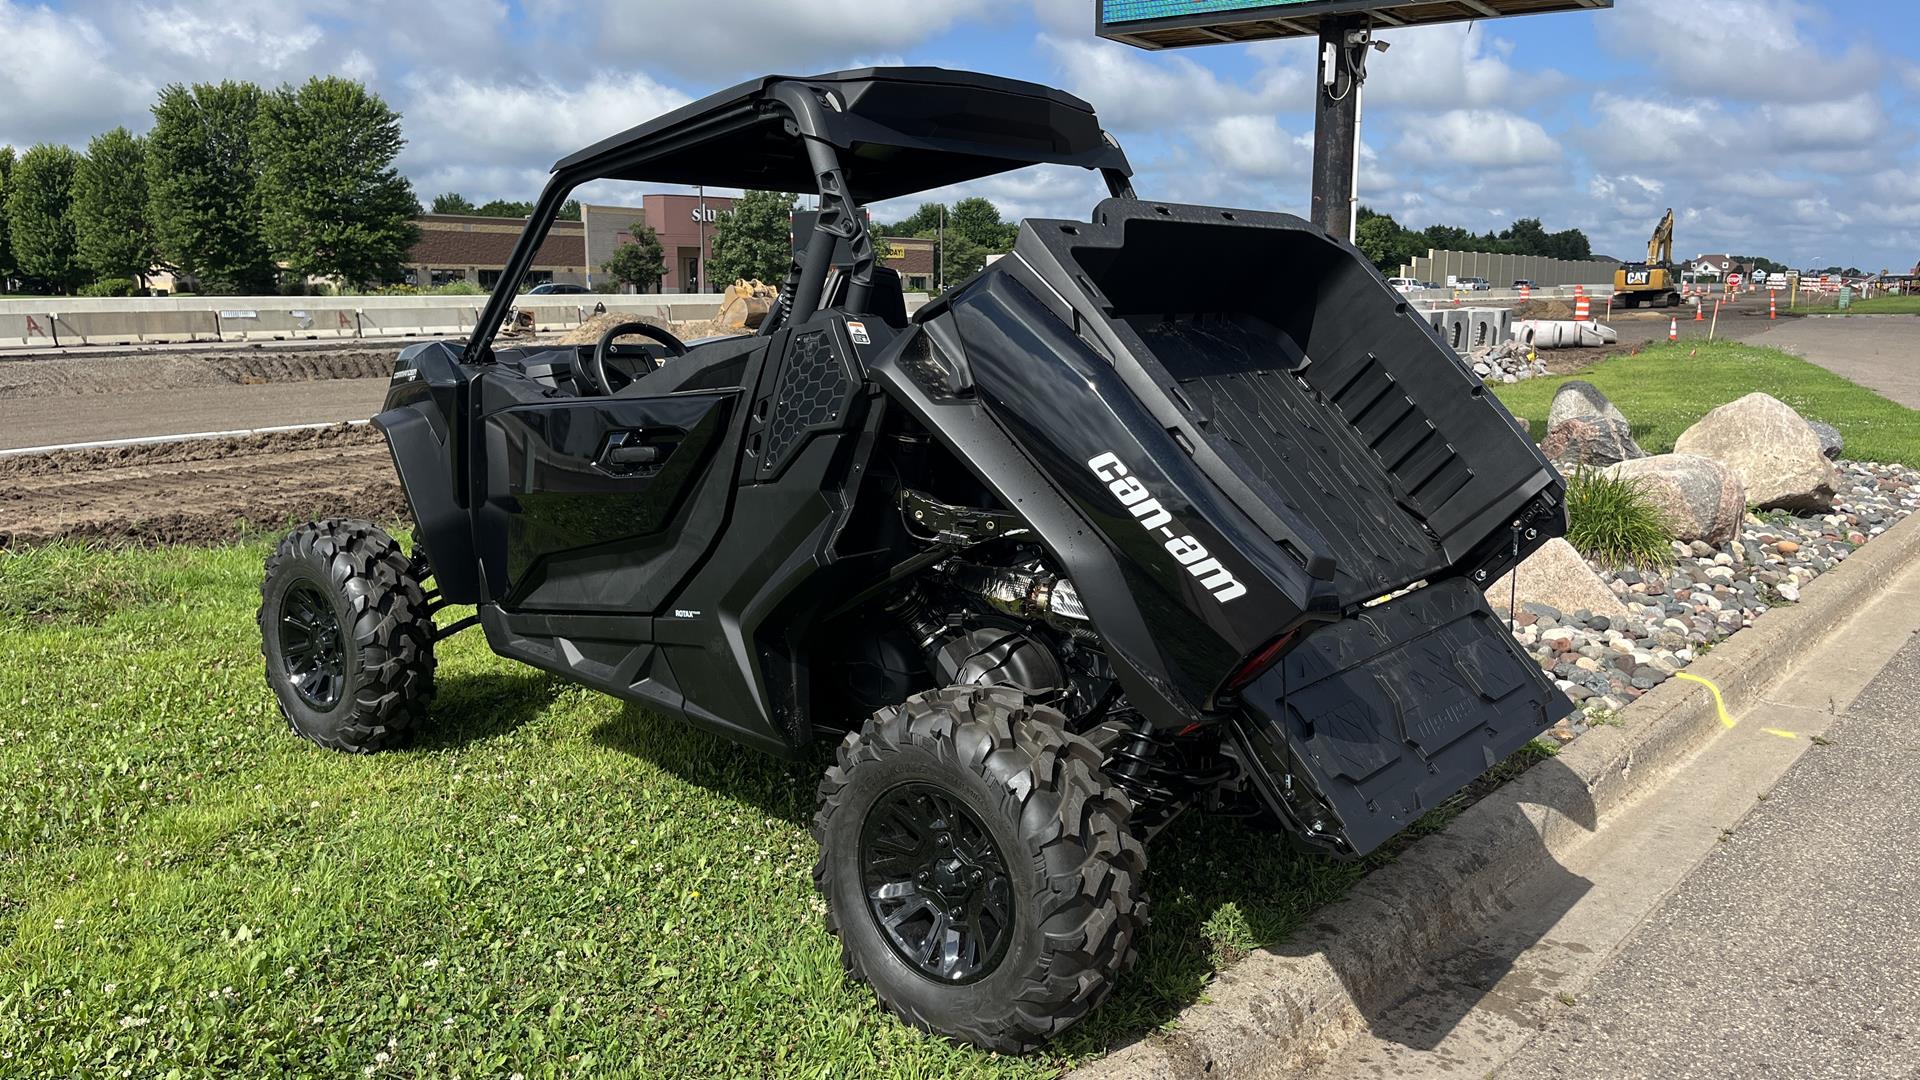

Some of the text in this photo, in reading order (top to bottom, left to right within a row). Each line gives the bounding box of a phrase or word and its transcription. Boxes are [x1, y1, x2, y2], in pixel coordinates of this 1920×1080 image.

[1627, 272, 1648, 284] CAT
[26, 316, 47, 337] A
[339, 311, 353, 329] A
[1087, 451, 1248, 603] can-am
